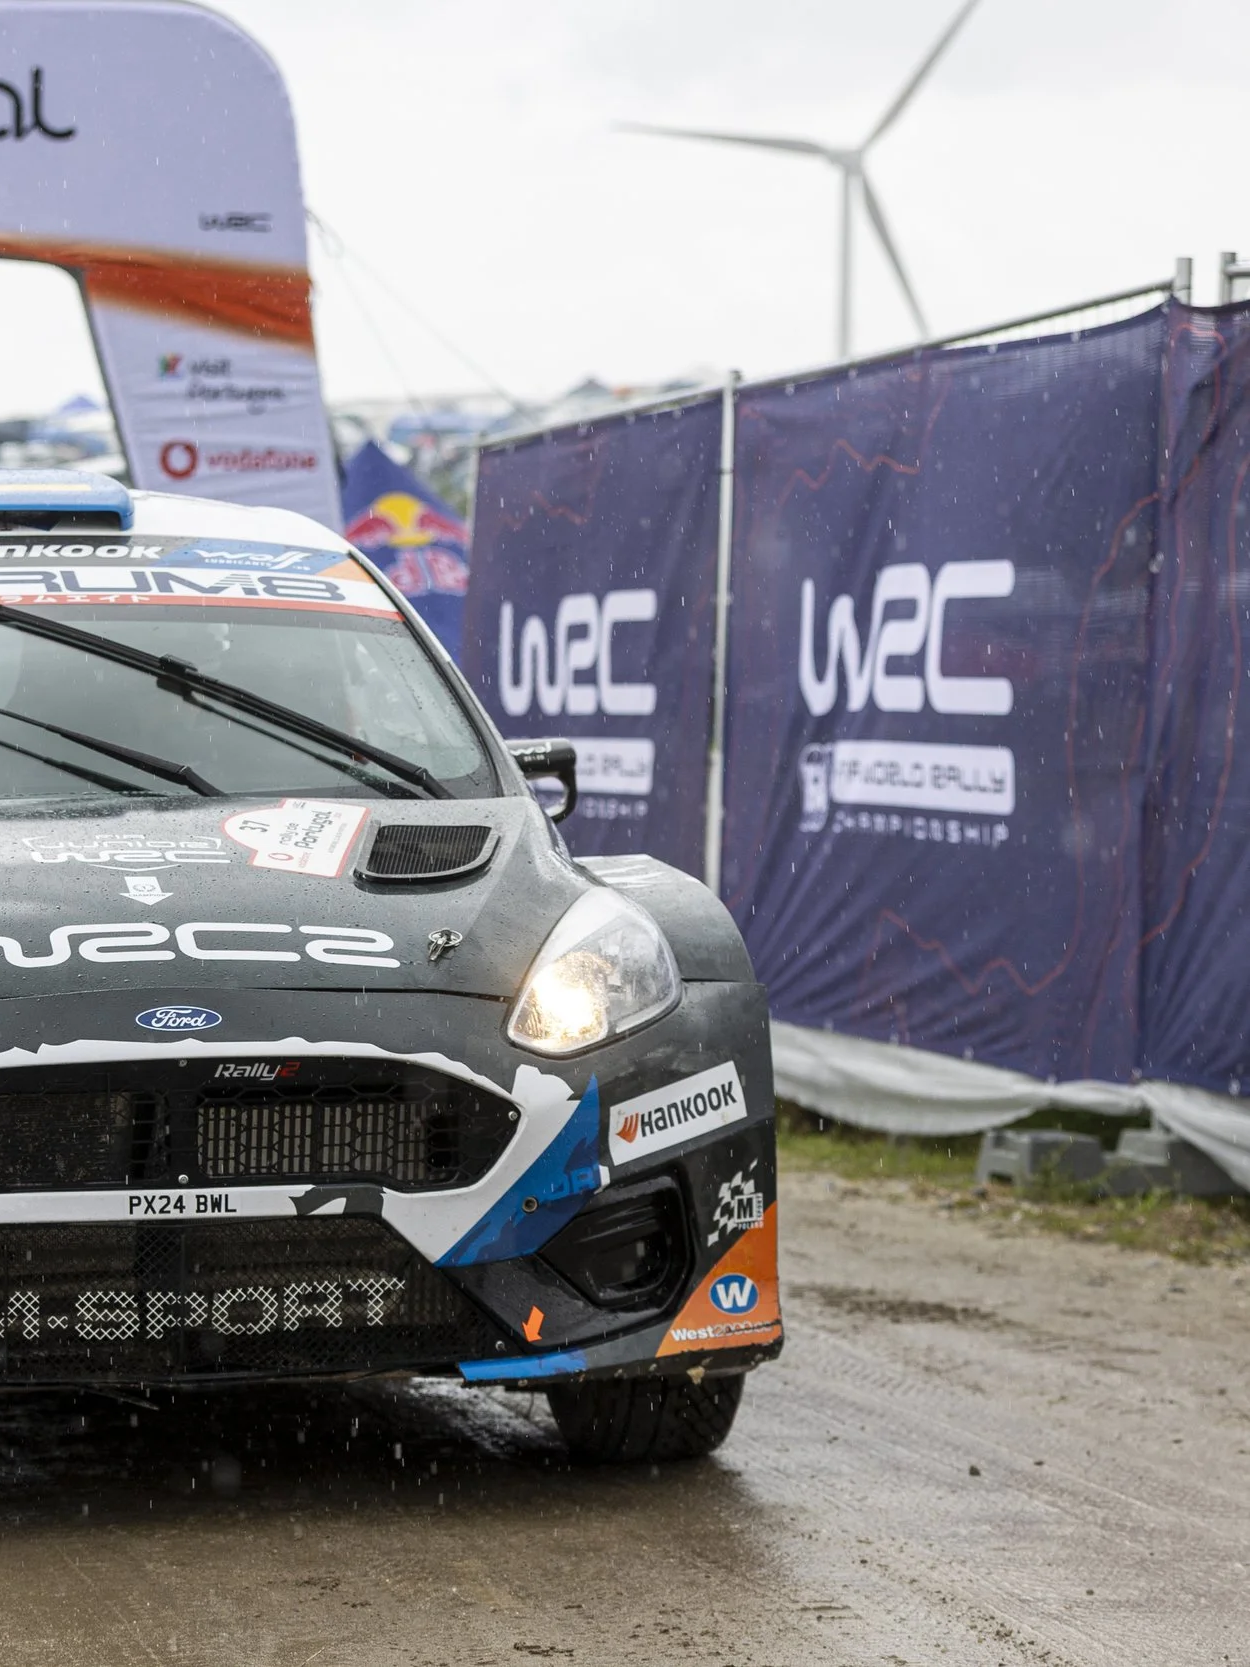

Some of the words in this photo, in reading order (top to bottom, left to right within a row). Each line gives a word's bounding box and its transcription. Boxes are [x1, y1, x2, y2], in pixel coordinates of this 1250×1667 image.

[798, 558, 1016, 717] WRC
[499, 588, 657, 716] WRC
[30, 849, 232, 864] WRC
[151, 1010, 207, 1028] Ford
[129, 1195, 187, 1215] PX24
[195, 1193, 238, 1213] BWL
[715, 1278, 753, 1309] W
